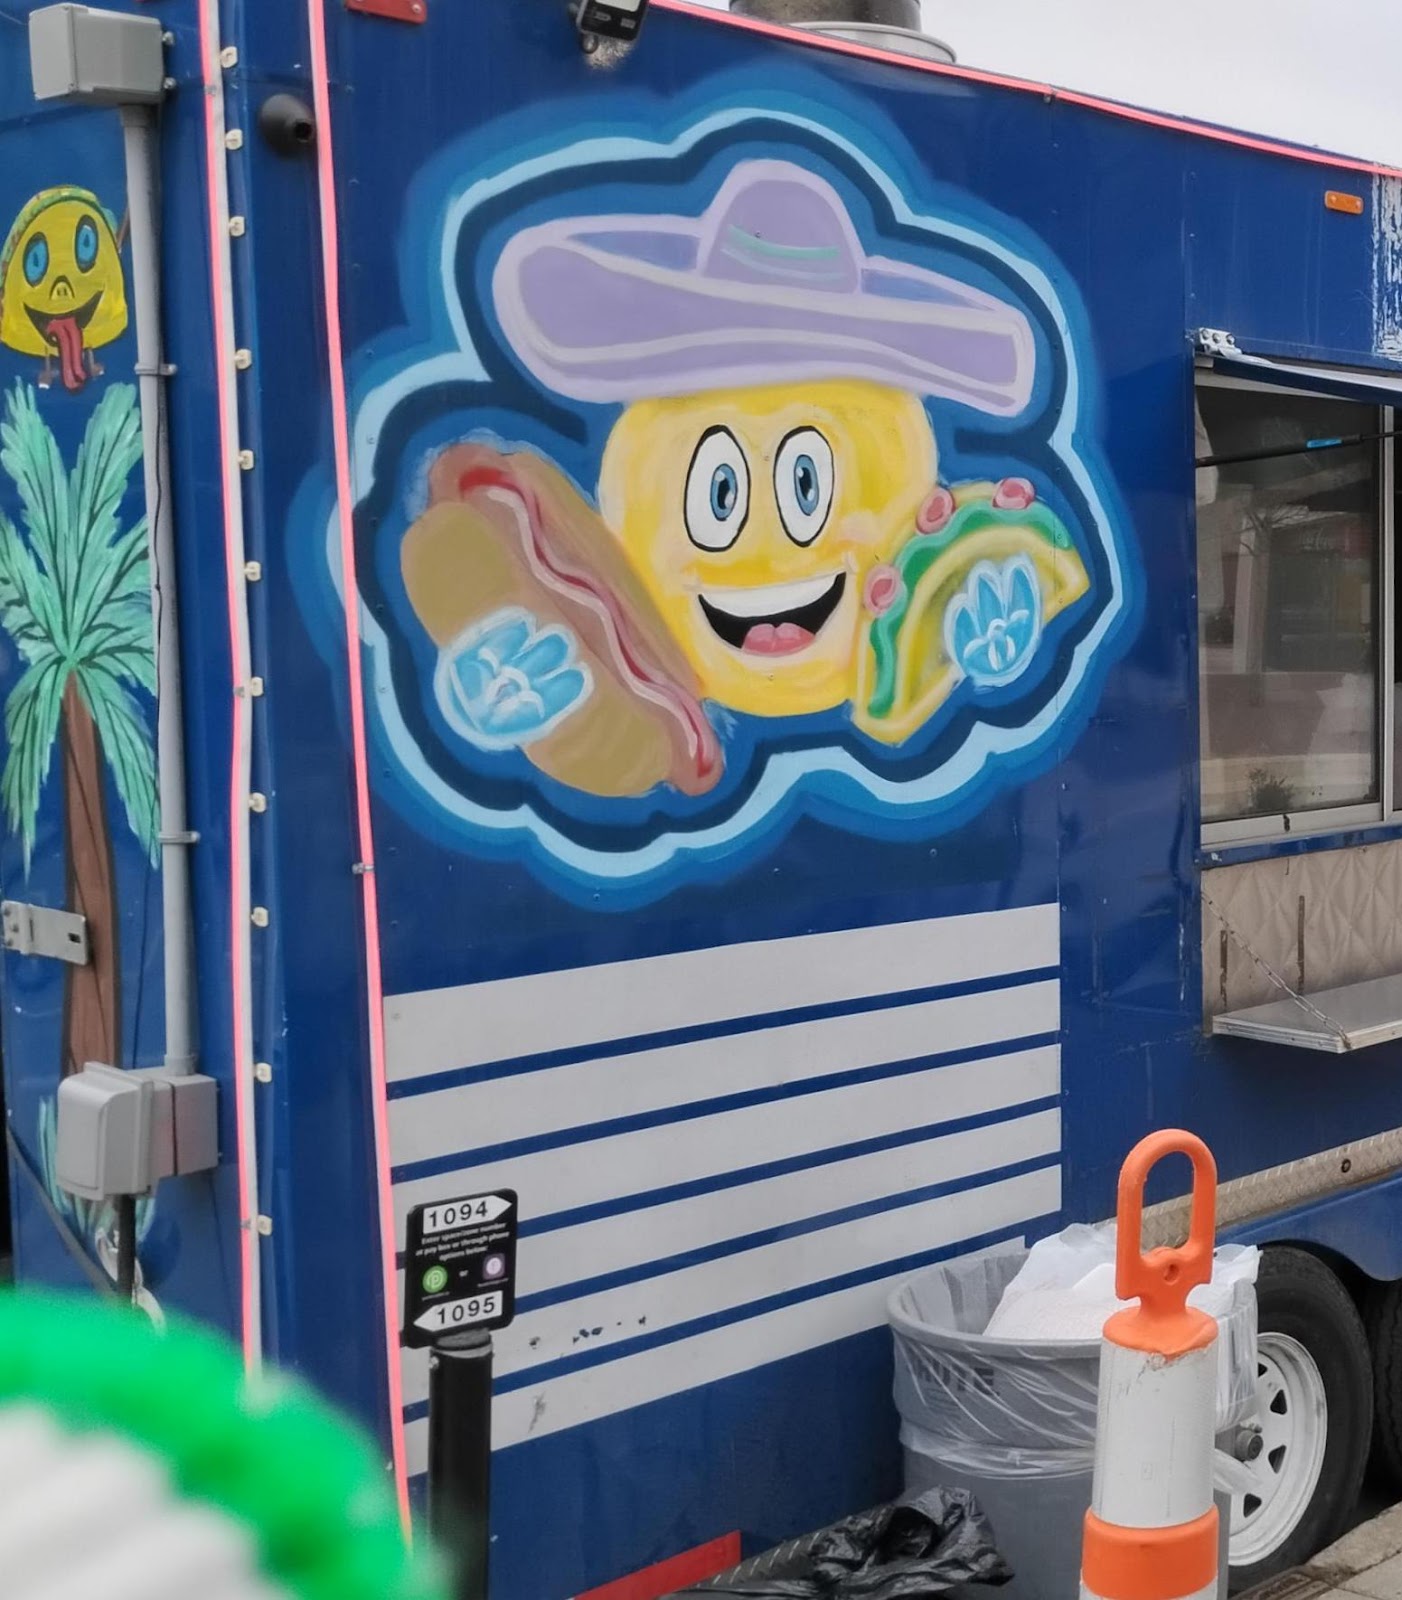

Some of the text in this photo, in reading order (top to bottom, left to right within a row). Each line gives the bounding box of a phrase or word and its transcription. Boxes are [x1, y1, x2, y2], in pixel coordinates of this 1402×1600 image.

[429, 1201, 488, 1228] 1094
[421, 1236, 440, 1245] Enter
[458, 1269, 469, 1278] or
[438, 1295, 495, 1324] 1095
